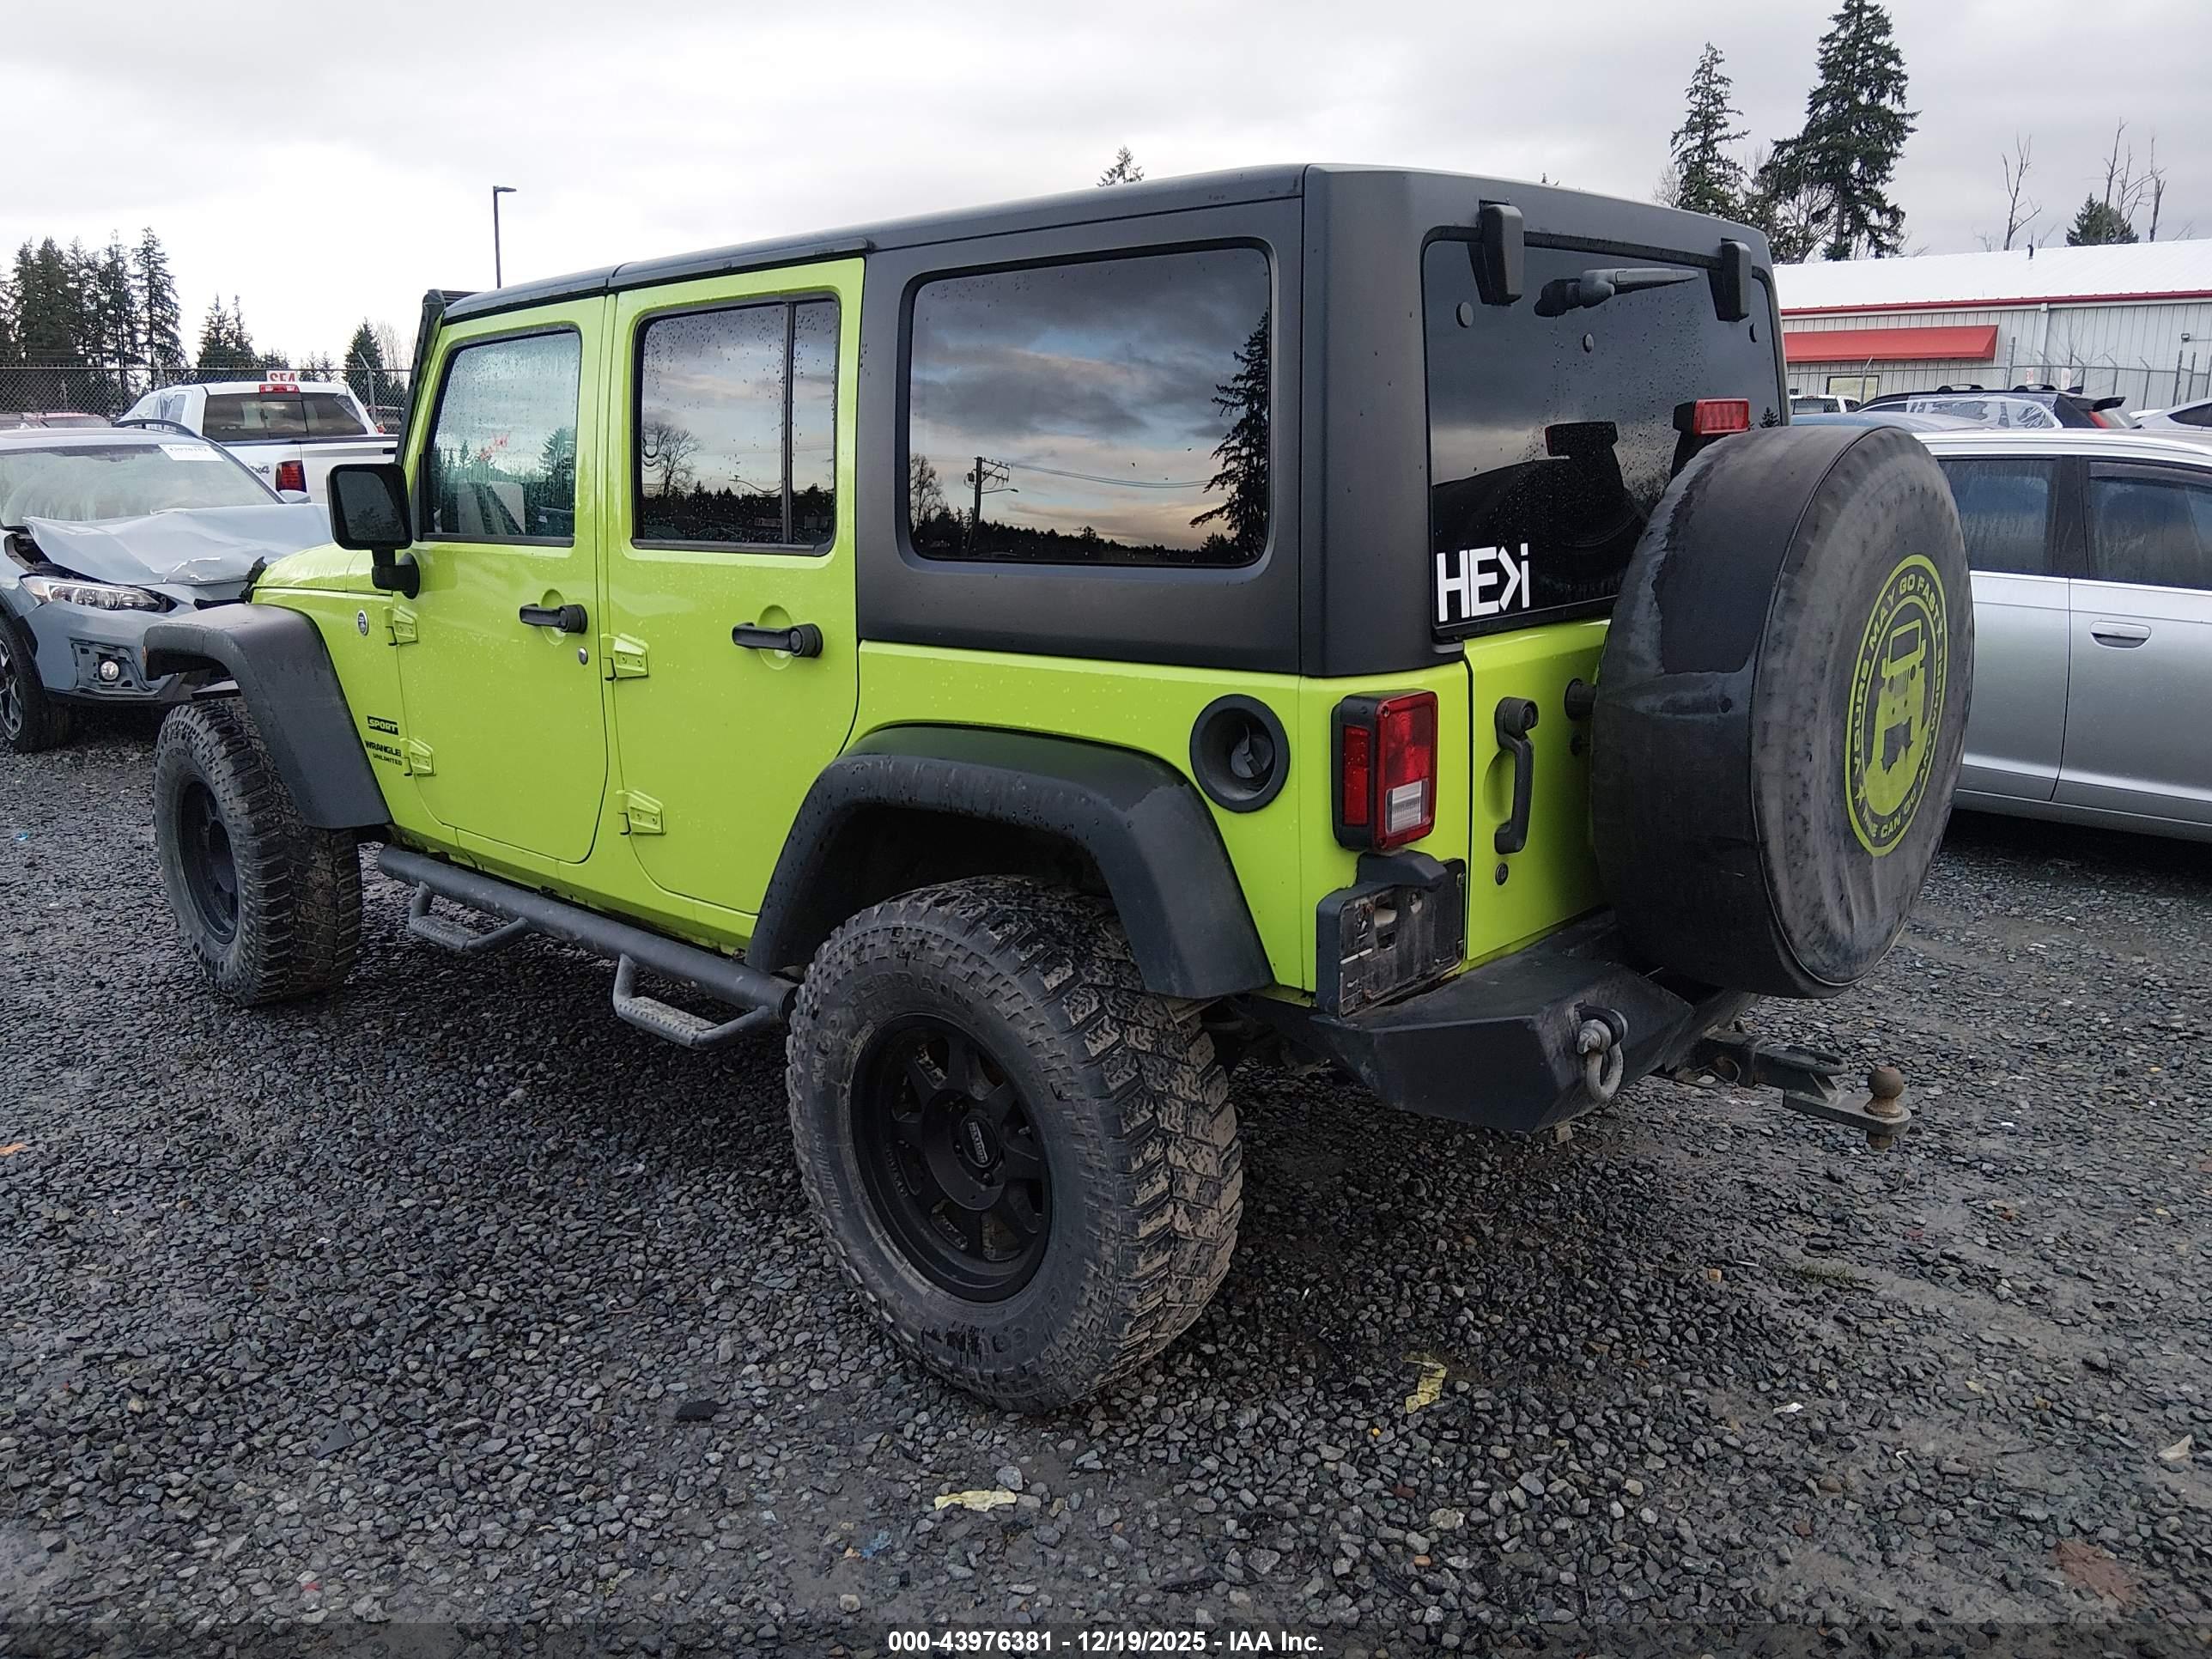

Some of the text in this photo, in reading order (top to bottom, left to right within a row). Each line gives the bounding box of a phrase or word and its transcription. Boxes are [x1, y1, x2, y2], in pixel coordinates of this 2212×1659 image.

[1853, 574, 1940, 778] YOURS MAY GO FAST
[368, 716, 398, 734] SPORT
[373, 752, 403, 766] UNLIMITED
[1880, 811, 1902, 839] CAN
